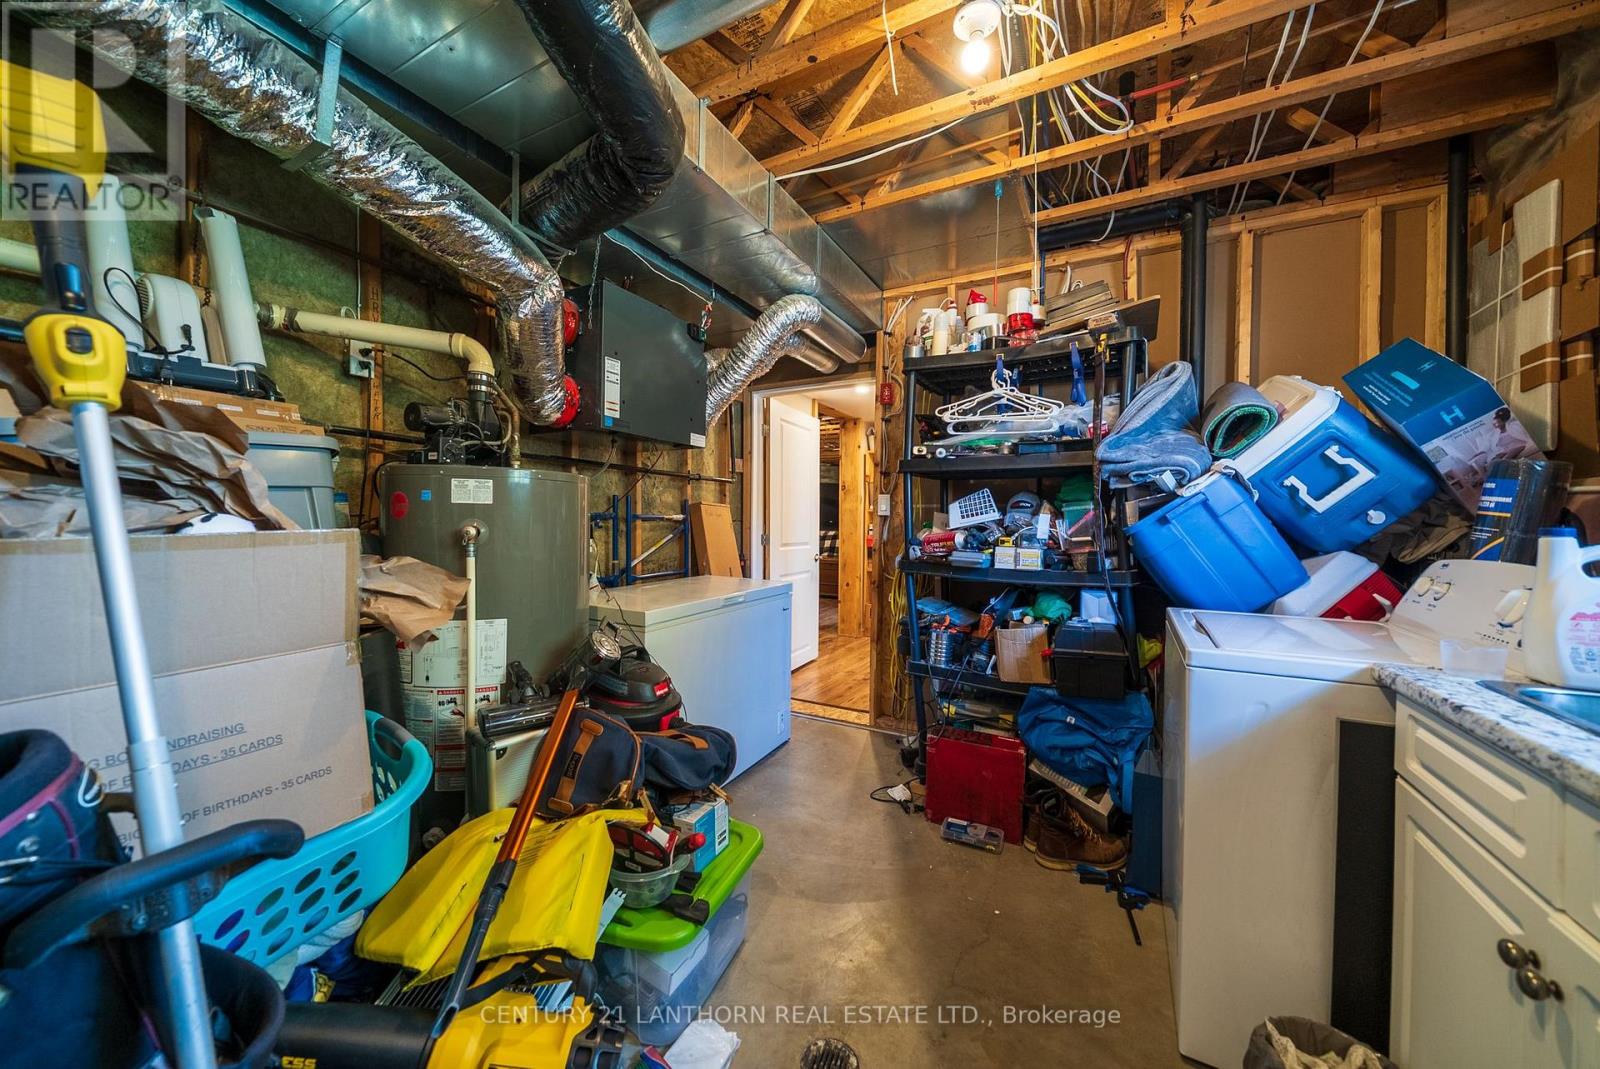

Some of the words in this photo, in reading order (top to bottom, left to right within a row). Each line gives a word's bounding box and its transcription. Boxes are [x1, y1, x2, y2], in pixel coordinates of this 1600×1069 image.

[1440, 404, 1466, 427] H
[105, 752, 128, 767] BO
[166, 722, 246, 750] NDRAISING
[221, 747, 236, 760] 35
[238, 734, 284, 755] CARDS
[181, 809, 202, 824] OF
[203, 785, 273, 817] BIRTHDAYS
[281, 778, 295, 791] 35
[295, 766, 333, 785] CARDS
